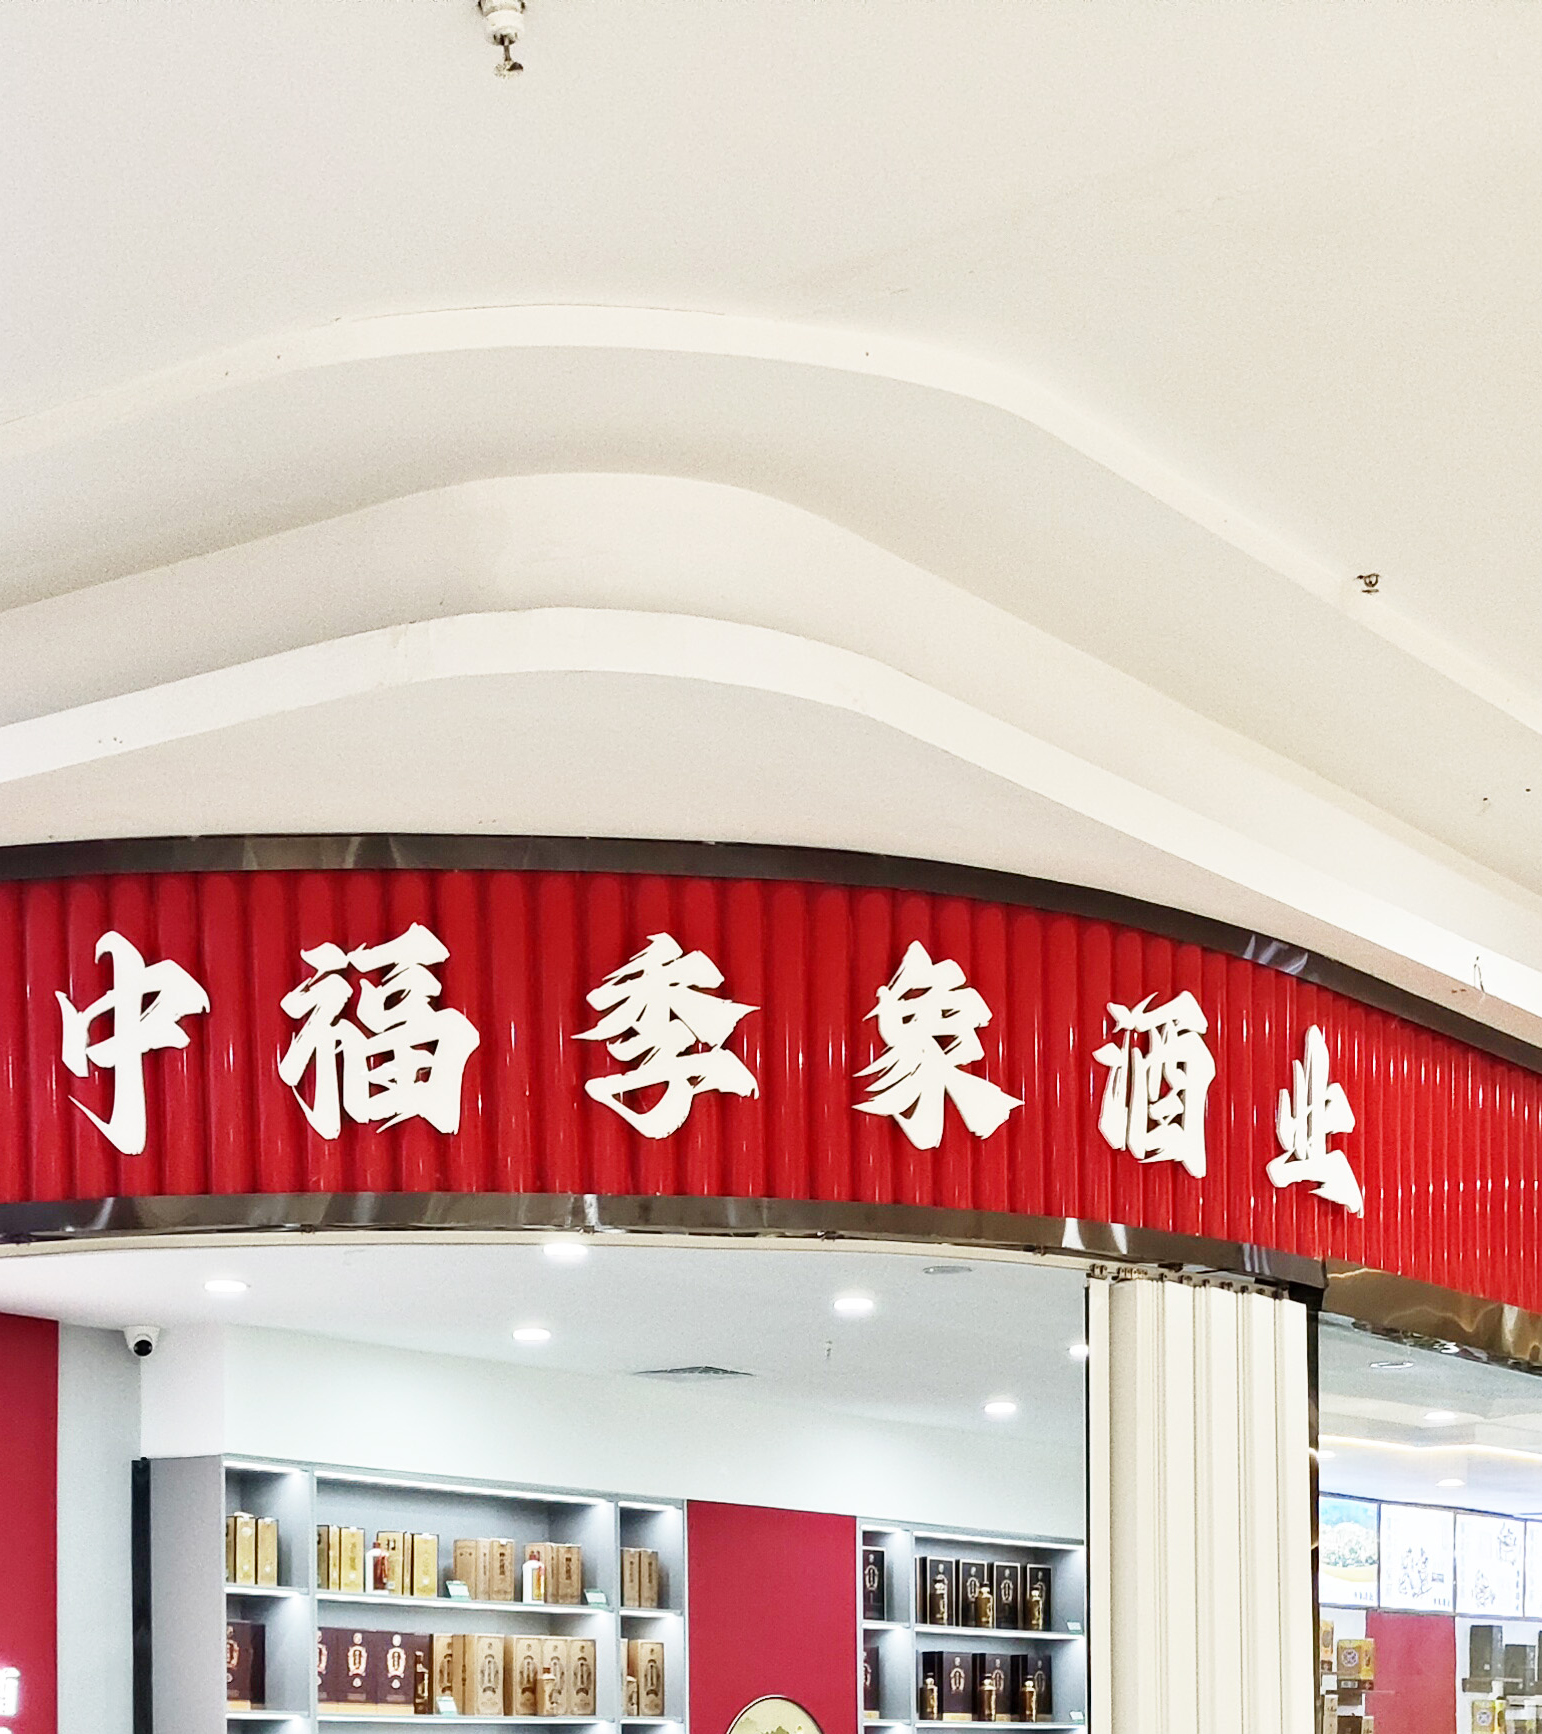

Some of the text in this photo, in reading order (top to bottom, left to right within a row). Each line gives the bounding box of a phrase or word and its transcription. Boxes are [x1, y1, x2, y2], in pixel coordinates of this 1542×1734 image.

[58, 922, 1363, 1219] 中福季象酒业
